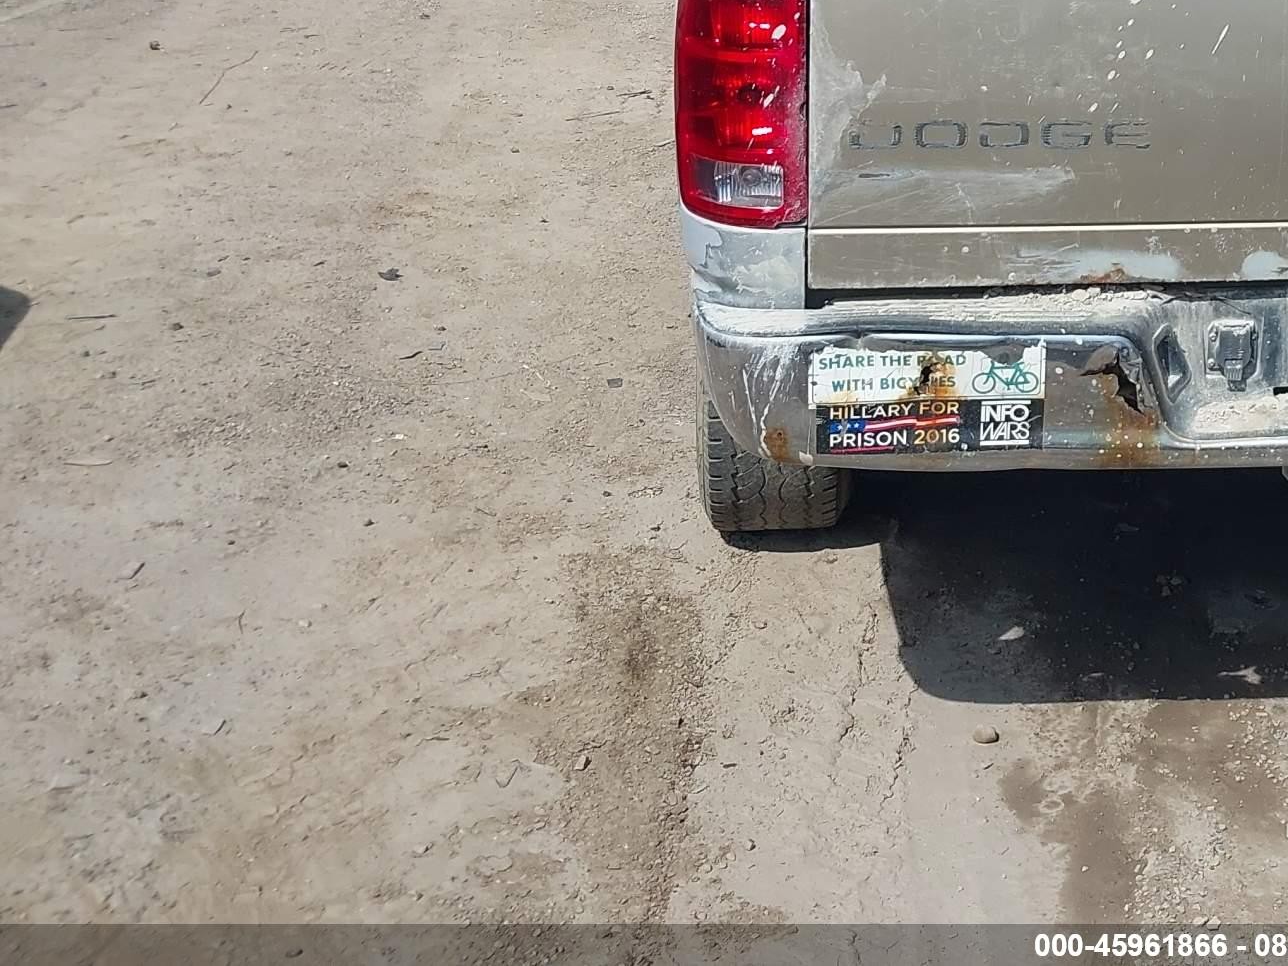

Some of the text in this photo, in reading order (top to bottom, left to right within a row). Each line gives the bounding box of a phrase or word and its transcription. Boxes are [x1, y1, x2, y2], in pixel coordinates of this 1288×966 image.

[849, 119, 1151, 149] DODGE
[819, 353, 967, 370] SHARE THE RAD
[832, 377, 873, 392] WITH
[829, 401, 959, 420] HILLARY FOR
[980, 404, 1030, 422] INFO
[829, 428, 960, 447] PRISON 2016
[980, 420, 1031, 440] WARS
